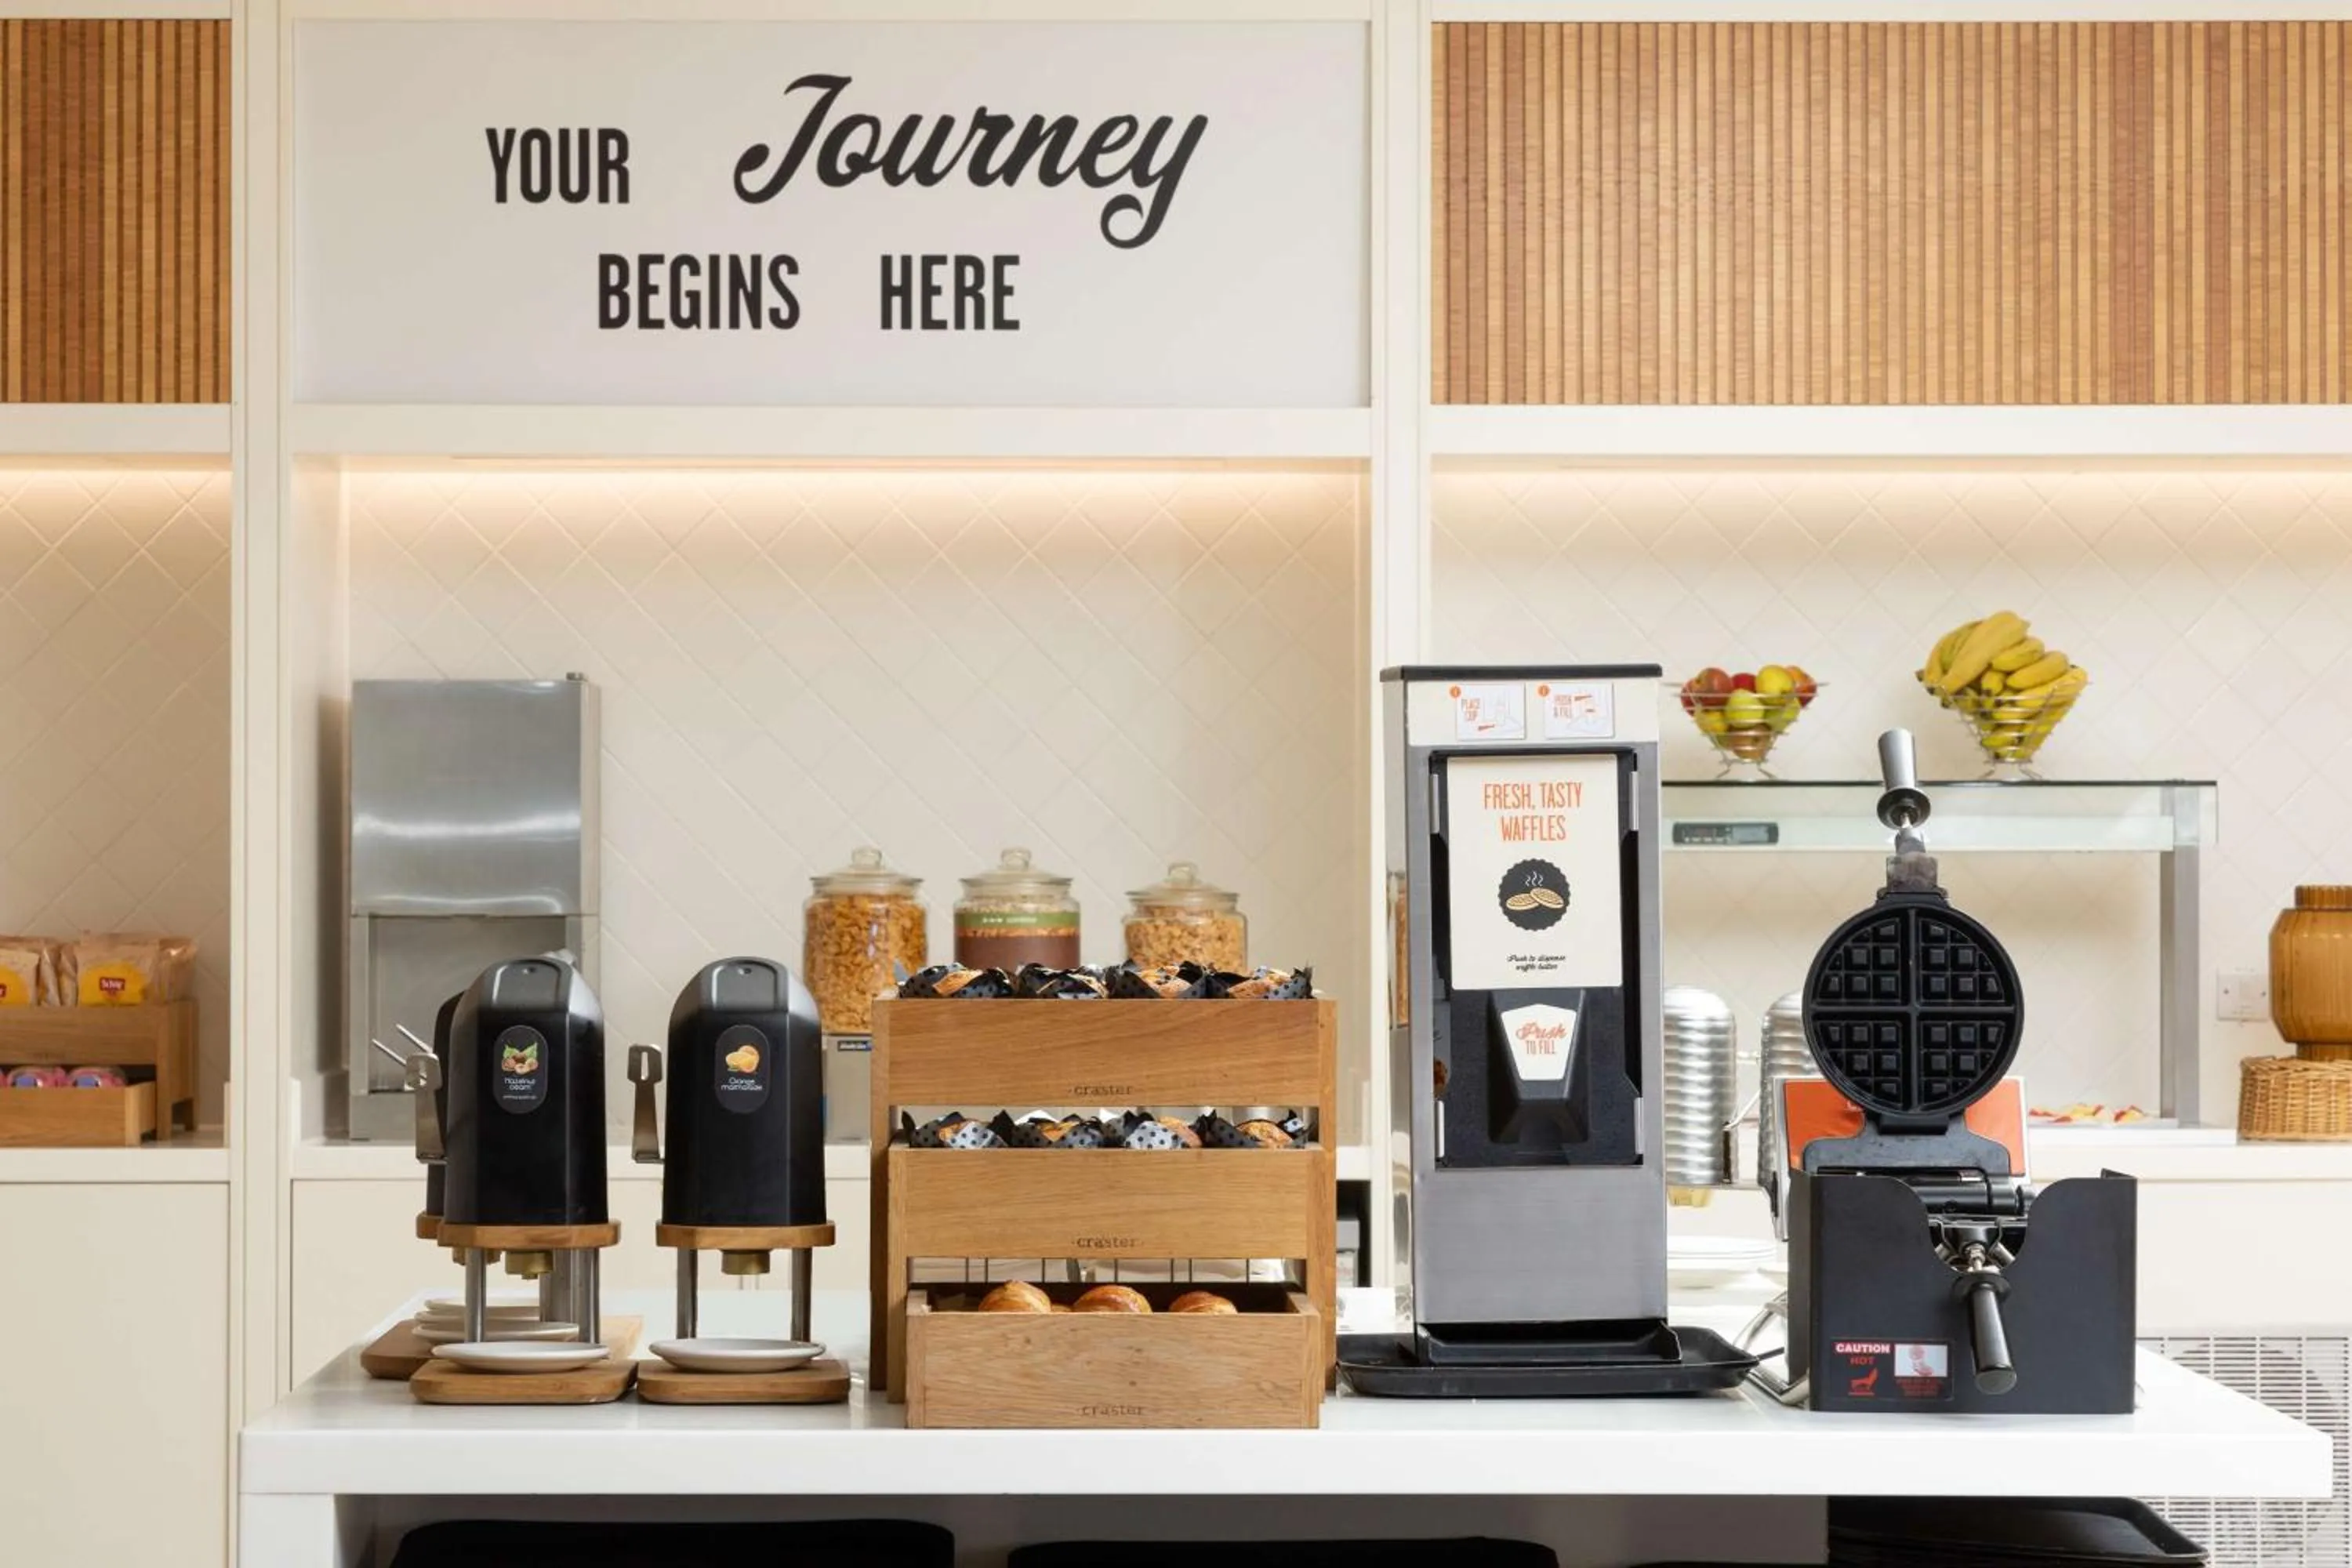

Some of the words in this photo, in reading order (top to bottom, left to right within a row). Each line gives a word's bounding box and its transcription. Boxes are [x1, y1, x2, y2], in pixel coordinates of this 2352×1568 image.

[486, 128, 629, 203] YOUR
[734, 74, 1207, 249] Journey
[599, 254, 800, 329] BEGINS
[881, 255, 1019, 329] HERE
[1483, 783, 1536, 811] FRESH,
[1541, 782, 1582, 808] TASTY
[1501, 815, 1566, 842] WAFFLES
[1515, 1022, 1566, 1040] Push
[1526, 1040, 1537, 1055] TO
[1539, 1040, 1556, 1055] FILL
[1835, 1343, 1891, 1354] CAUTION
[1850, 1356, 1875, 1365] HOT
